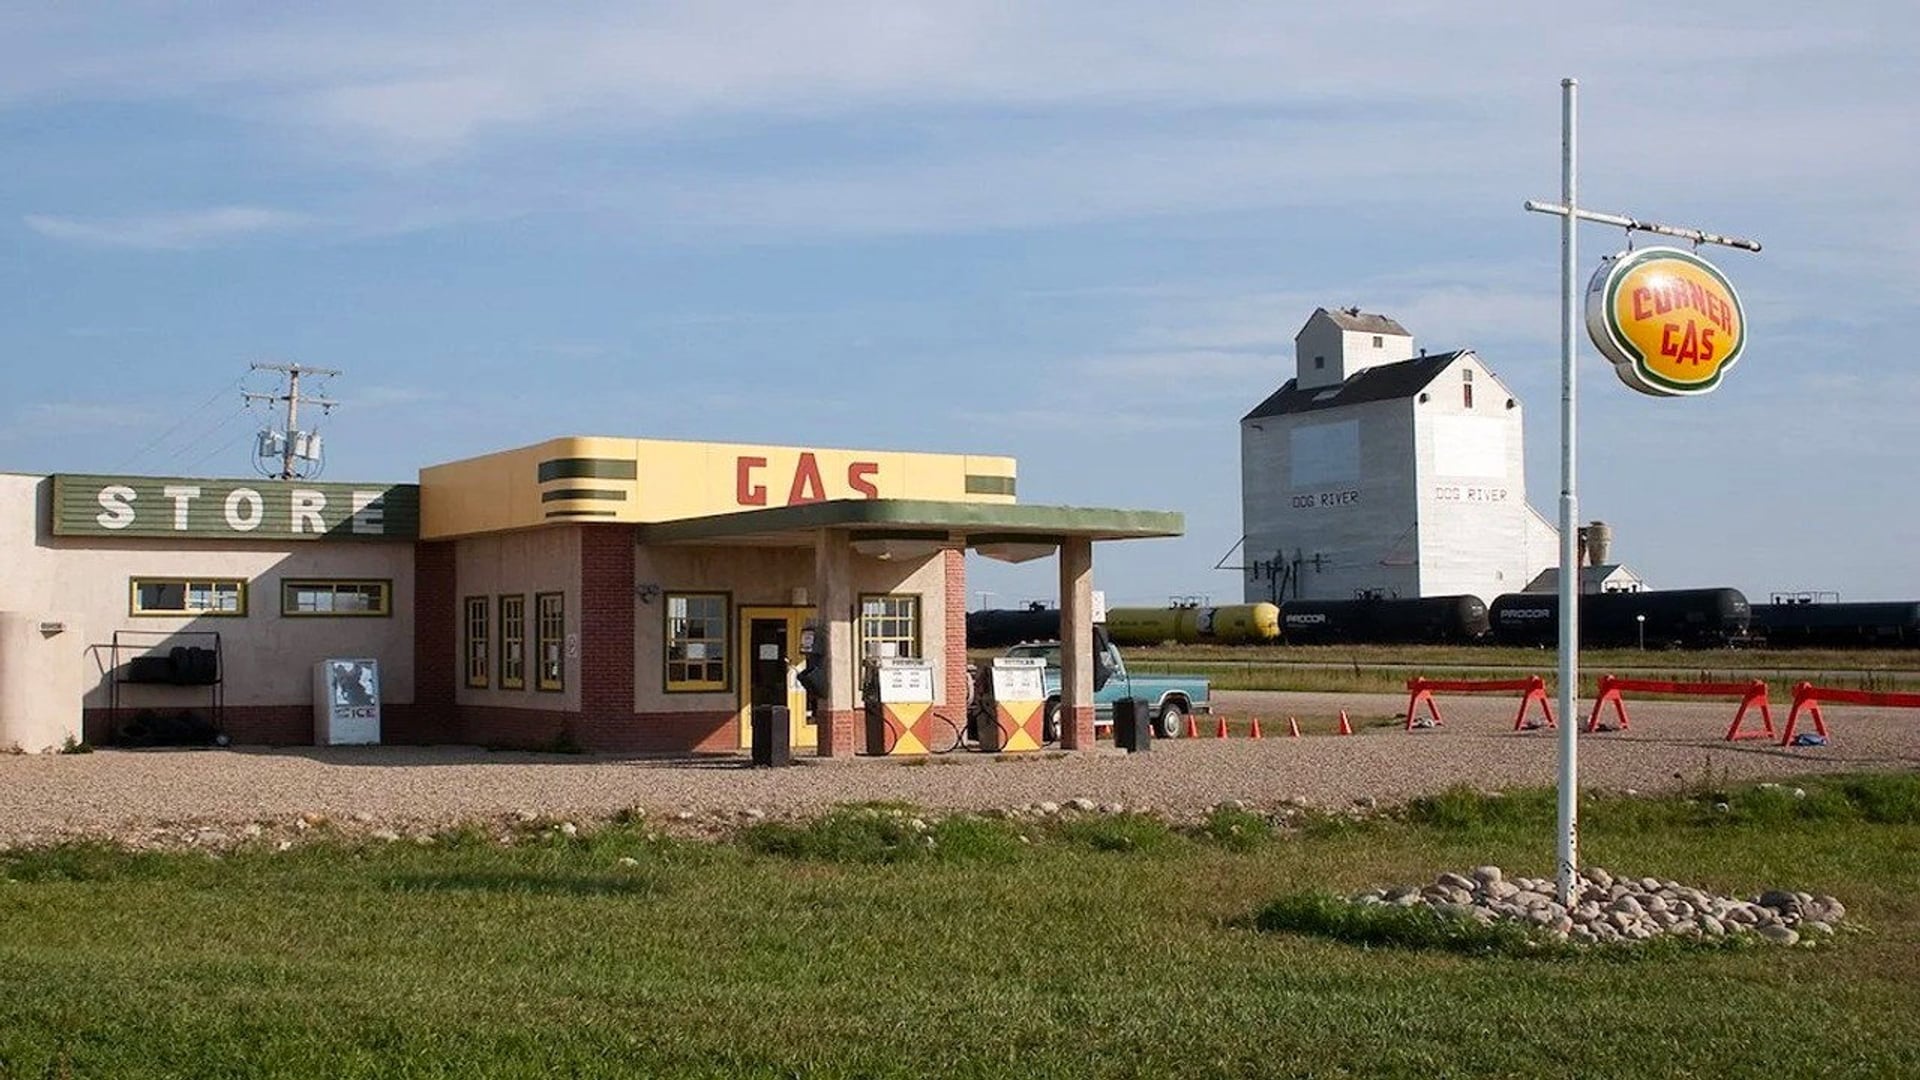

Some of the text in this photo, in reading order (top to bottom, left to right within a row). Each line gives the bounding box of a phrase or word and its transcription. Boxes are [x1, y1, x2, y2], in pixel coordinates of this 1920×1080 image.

[1633, 277, 1732, 336] CORNER
[1661, 320, 1714, 365] GAS
[737, 452, 878, 506] GAS
[1435, 487, 1508, 502] DOG RIVER
[96, 485, 384, 533] STORE
[1292, 490, 1359, 508] DOG RIVER
[1500, 608, 1550, 619] PROCOR
[352, 708, 375, 718] ICE
